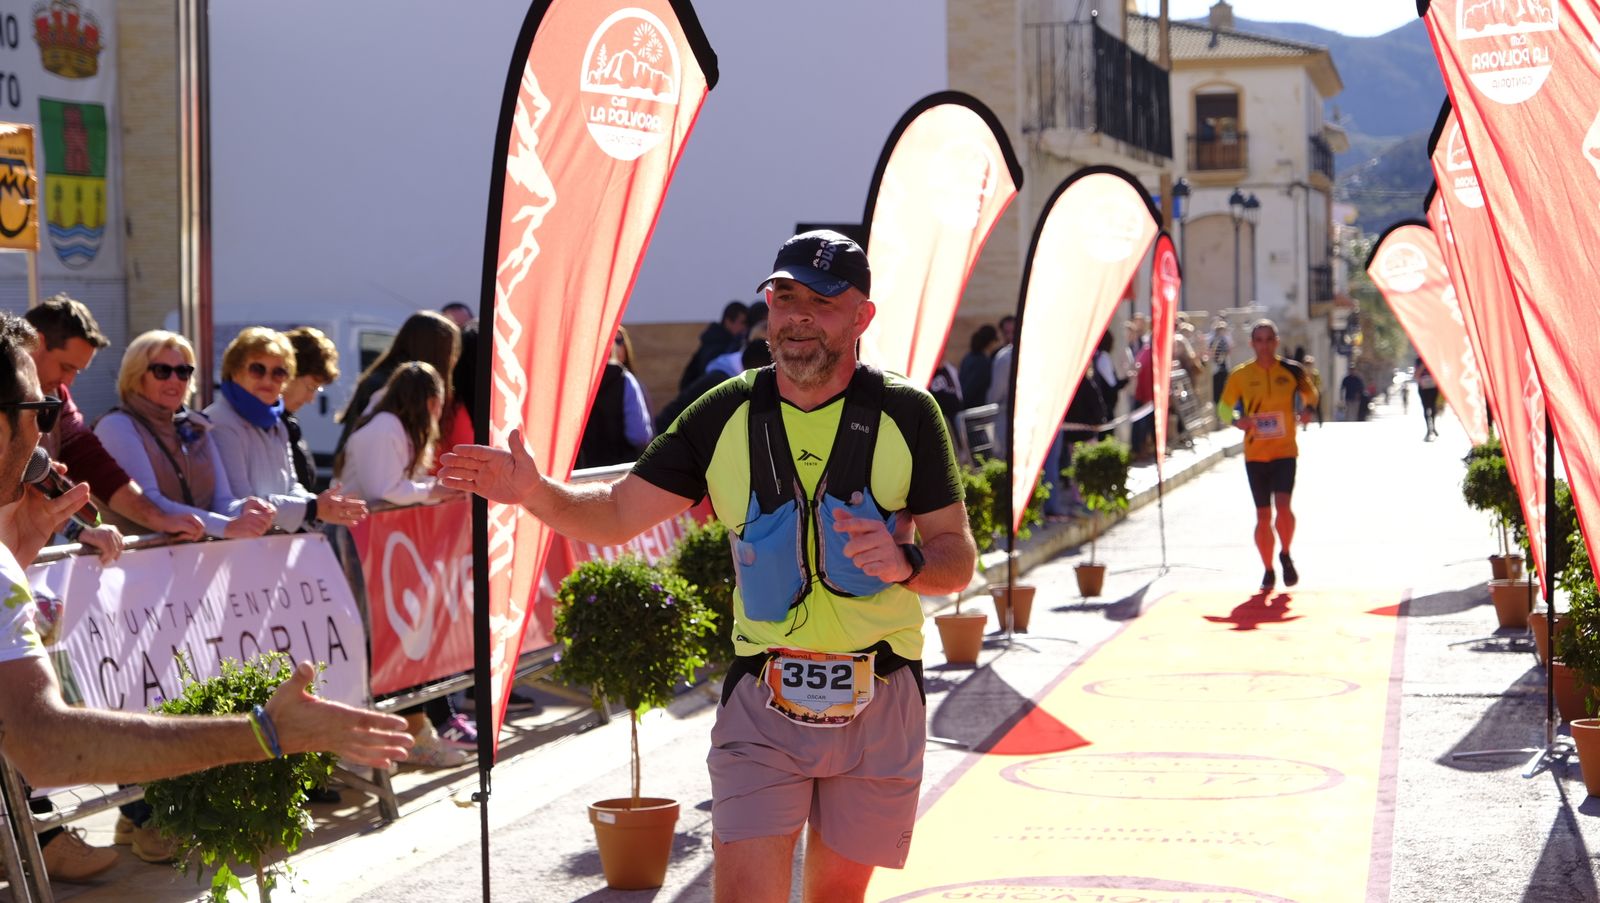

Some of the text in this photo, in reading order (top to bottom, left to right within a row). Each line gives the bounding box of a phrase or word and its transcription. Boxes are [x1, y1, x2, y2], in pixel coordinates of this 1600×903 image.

[590, 106, 660, 130] LA POLVORA
[87, 578, 333, 643] AYUNTAMIENTO DE
[98, 614, 350, 711] CANTORIA
[782, 662, 852, 690] 352
